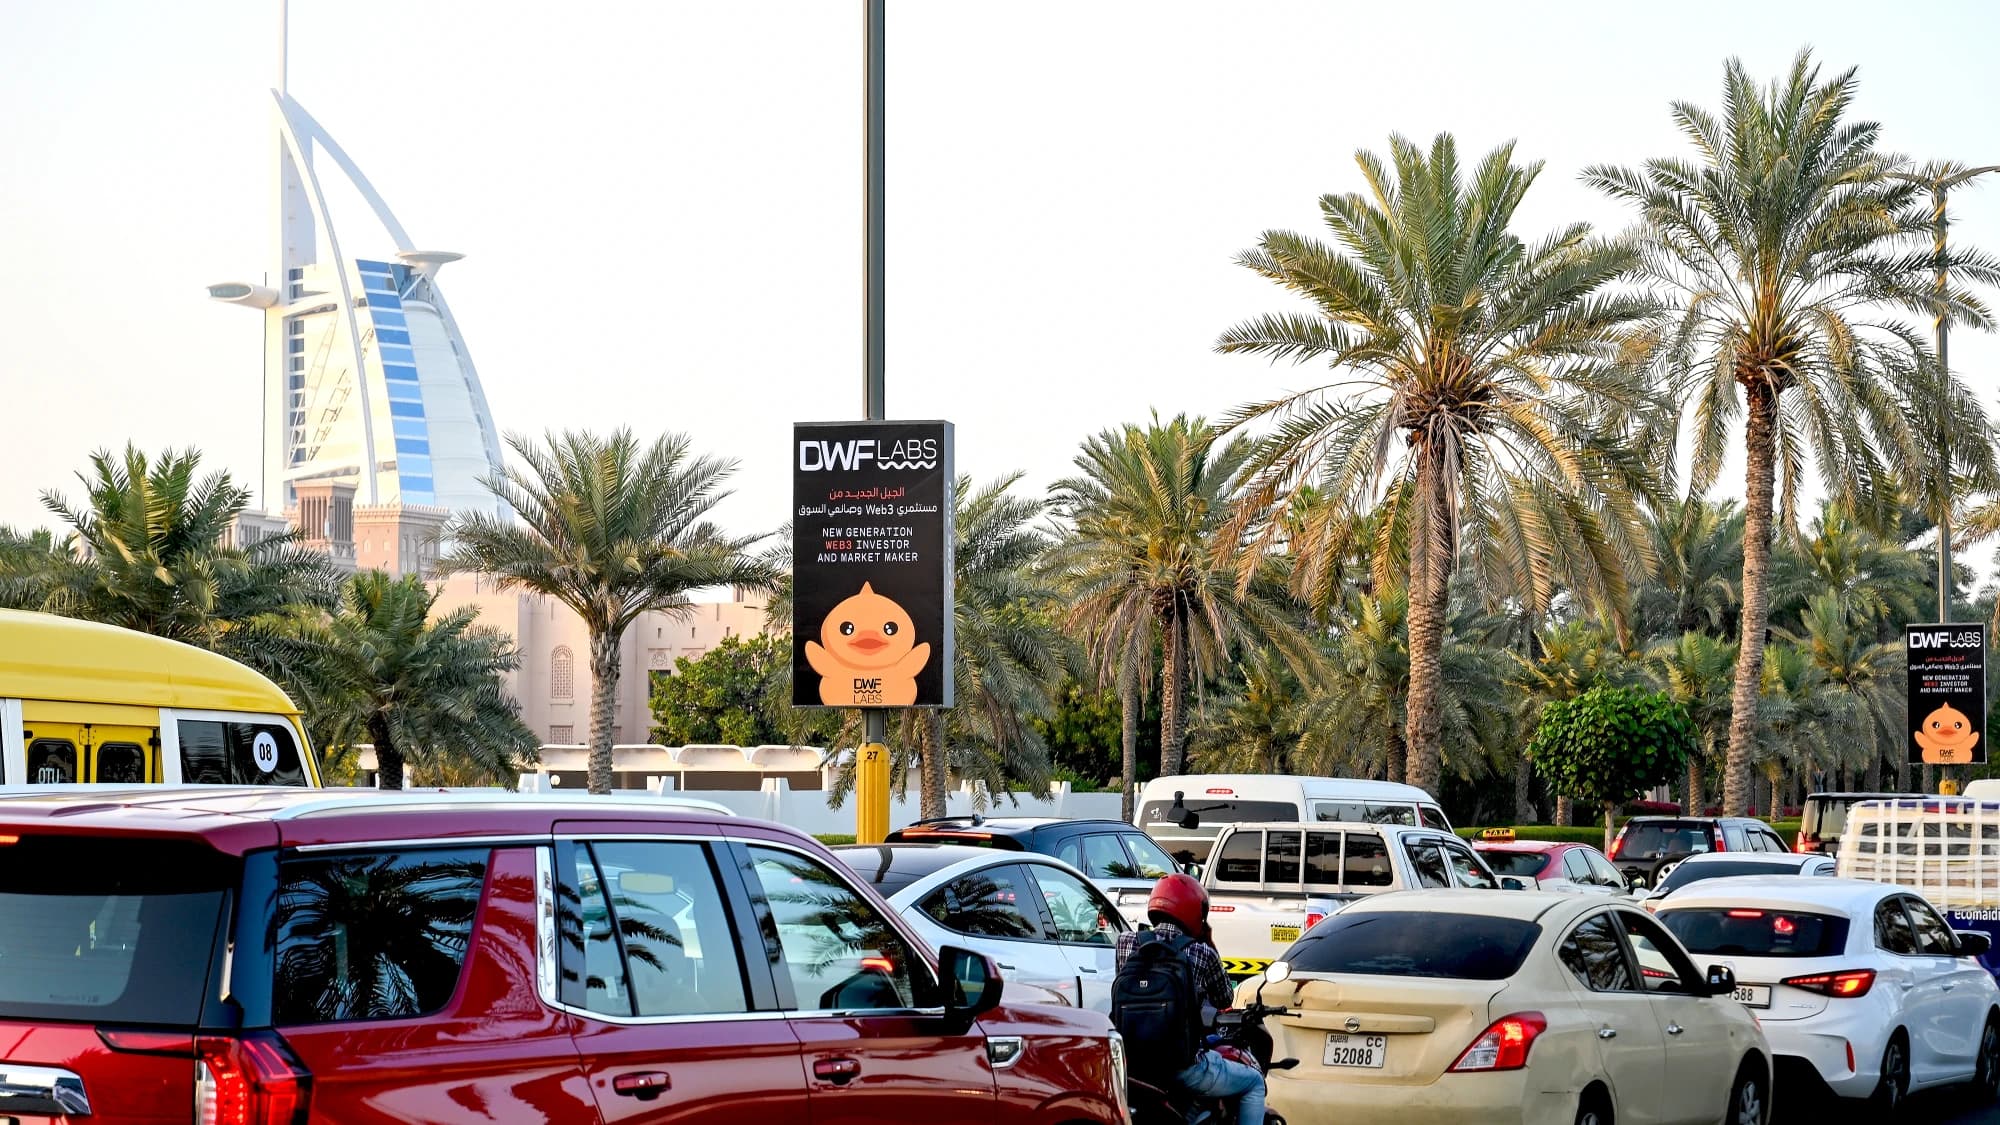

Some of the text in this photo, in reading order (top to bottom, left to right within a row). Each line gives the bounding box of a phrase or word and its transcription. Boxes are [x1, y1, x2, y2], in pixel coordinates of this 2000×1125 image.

[800, 439, 937, 471] DWF LABS
[829, 488, 844, 501] من
[880, 486, 905, 500] الجيل
[798, 504, 826, 516] السوق
[866, 504, 894, 515] Web3
[822, 527, 913, 537] NEW GENERATION
[825, 539, 910, 550] WEB3 INVESTOR
[817, 552, 918, 563] AND MARKET MAKER
[1909, 631, 1981, 648] DWF LABS
[853, 678, 882, 689] DWF
[853, 694, 882, 704] LABS
[259, 743, 272, 761] 08
[866, 751, 878, 760] 27
[1954, 906, 2000, 920] ecomaid
[1366, 1036, 1382, 1047] CC
[1333, 1048, 1373, 1065] 52088
